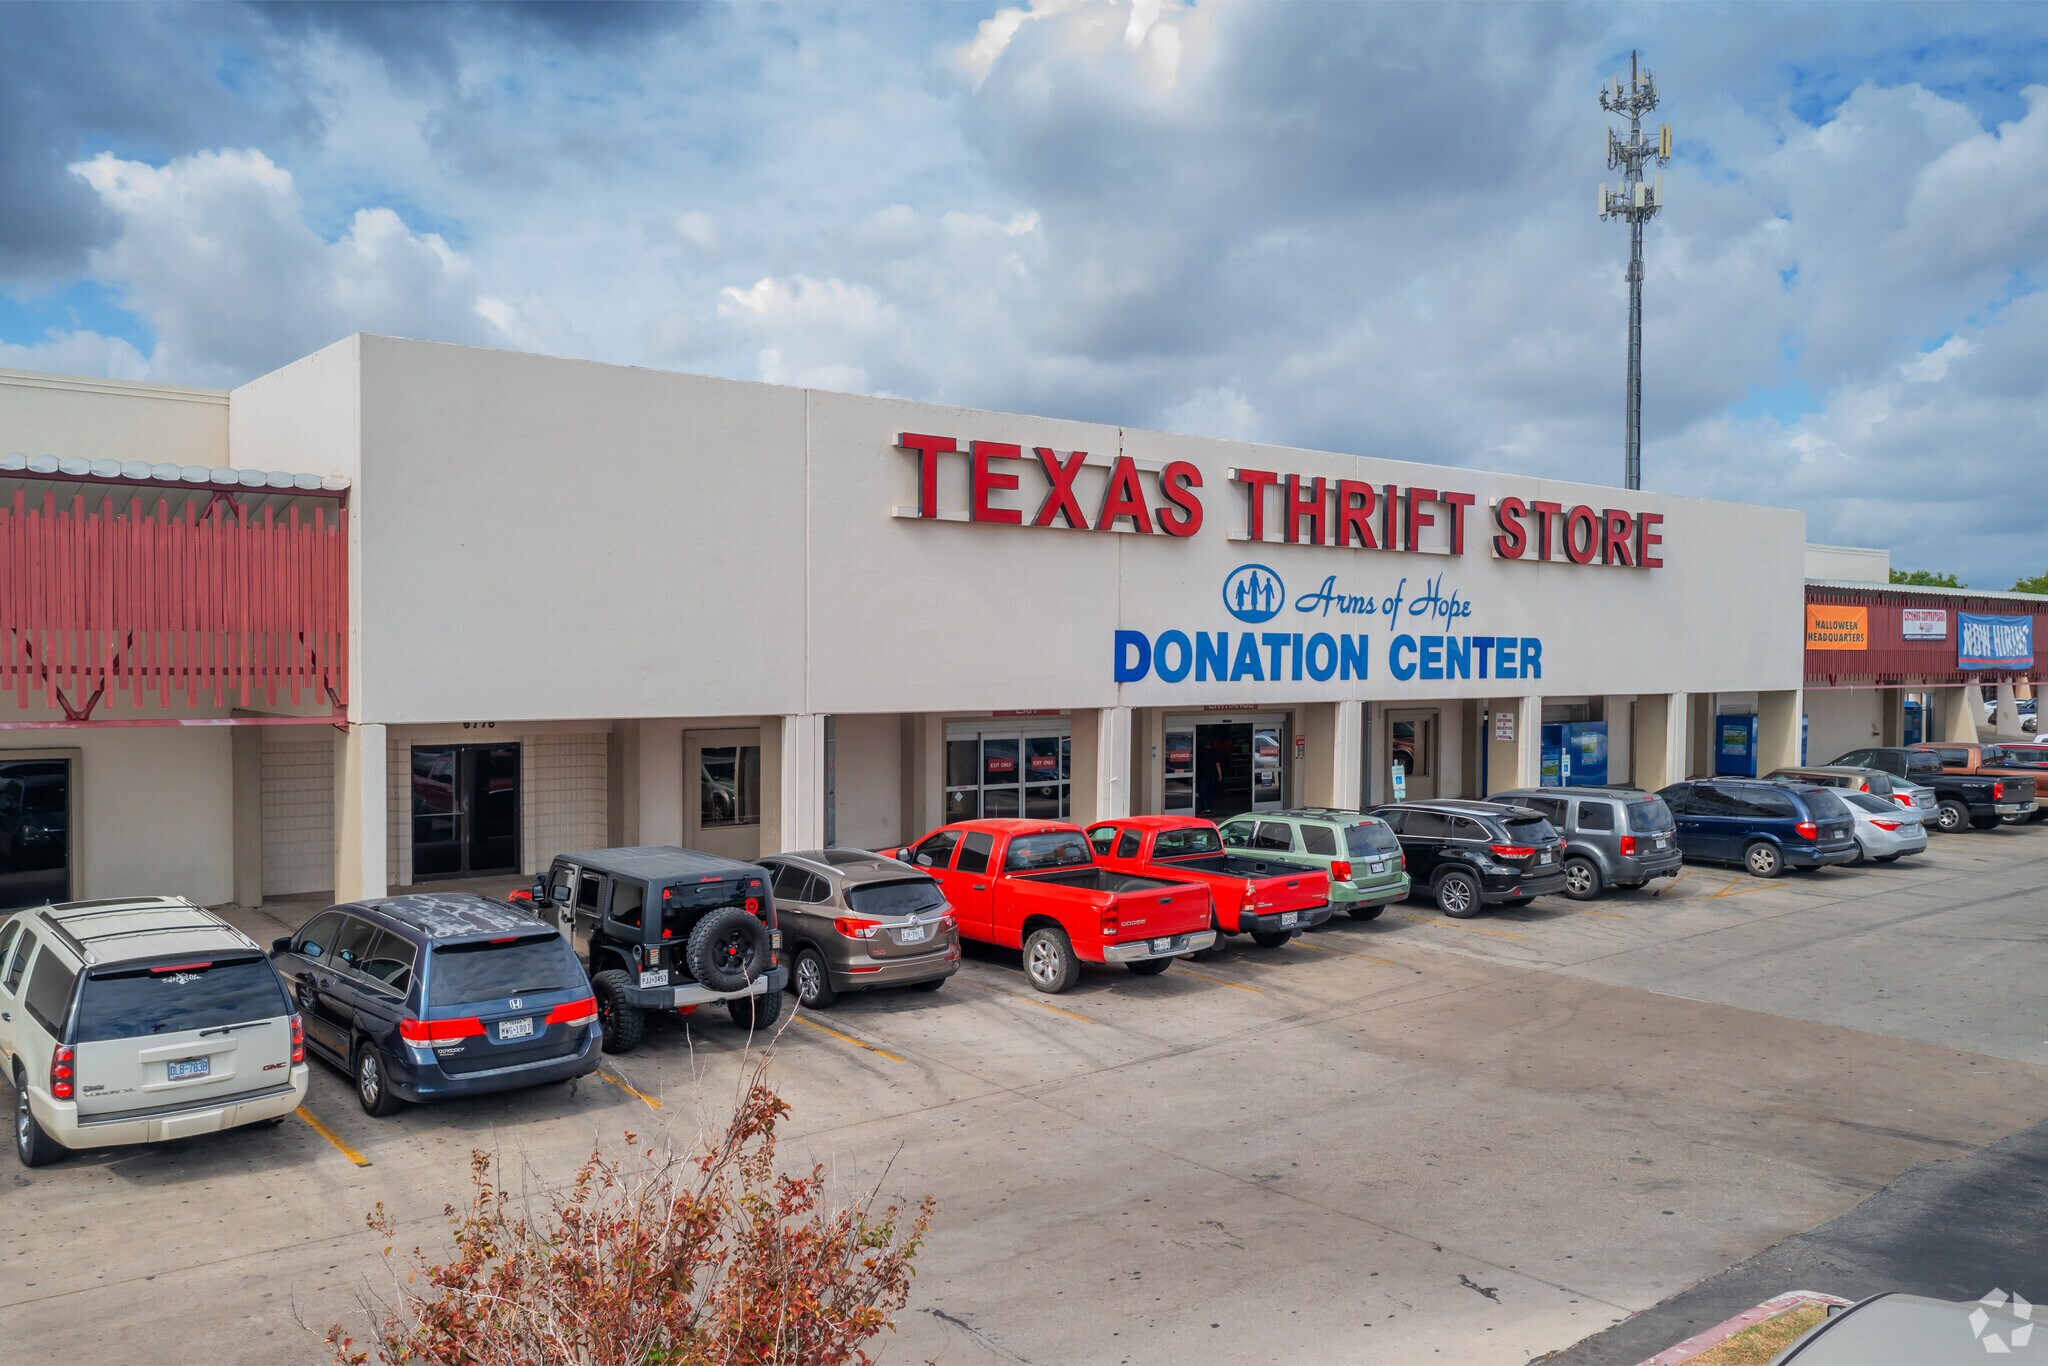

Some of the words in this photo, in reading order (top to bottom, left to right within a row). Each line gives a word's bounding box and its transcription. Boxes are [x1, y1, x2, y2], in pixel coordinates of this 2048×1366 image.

[899, 432, 1204, 537] TEXAS
[1235, 468, 1475, 556] THRIFT
[1493, 496, 1664, 568] STORE
[1295, 575, 1378, 617] Arms
[1382, 578, 1407, 631] of
[1408, 571, 1472, 632] Hope
[1815, 620, 1858, 630] HALLOWEEN
[1807, 632, 1865, 642] HEADQUARTERS
[1963, 622, 1991, 657] NOW
[1992, 624, 2029, 657] HIRING
[1114, 629, 1369, 683] DONATION
[1389, 634, 1542, 681] CENTER
[1121, 919, 1146, 927] DODGE
[263, 1061, 287, 1071] GMC
